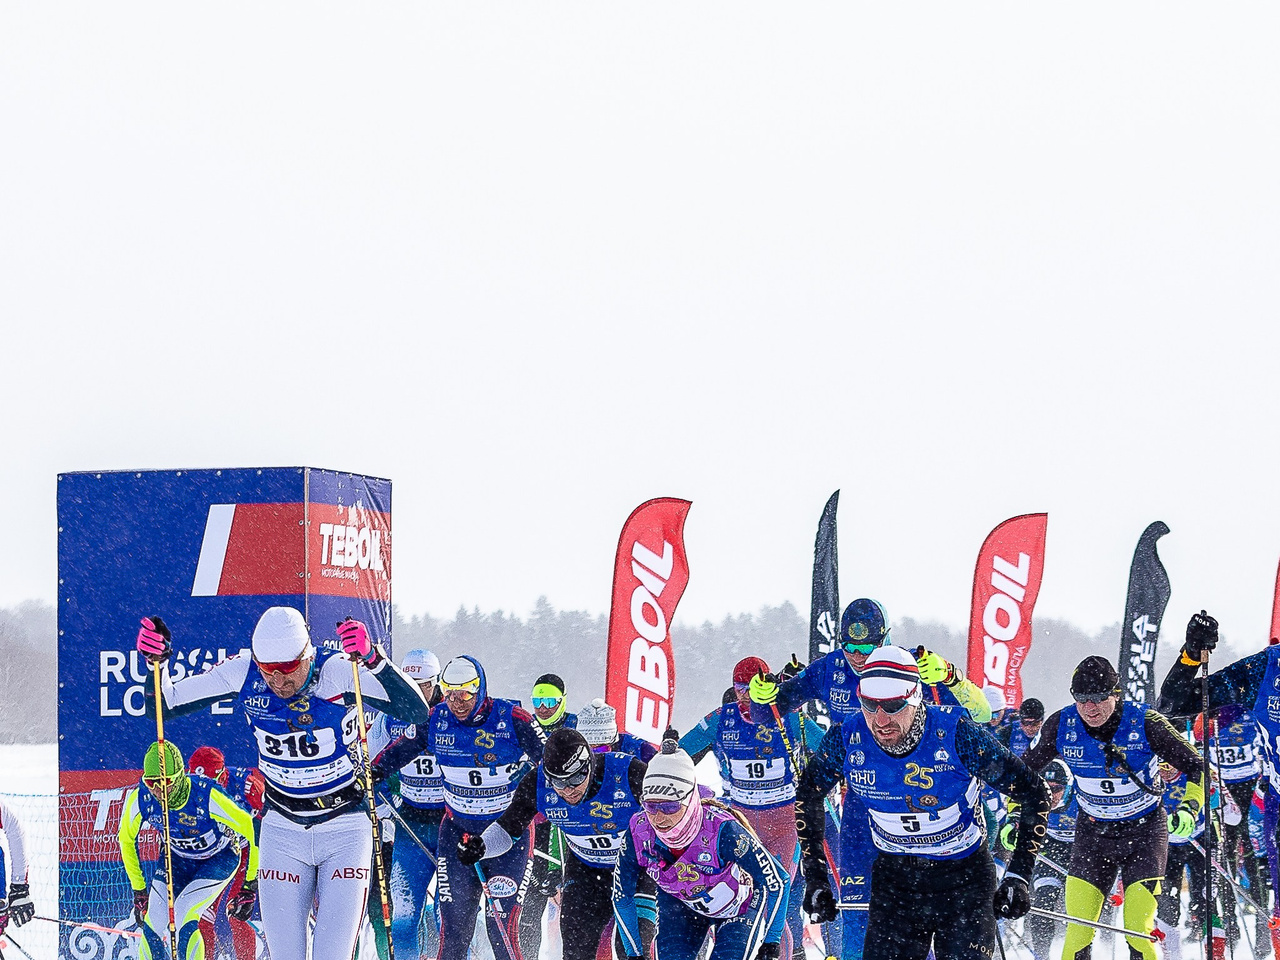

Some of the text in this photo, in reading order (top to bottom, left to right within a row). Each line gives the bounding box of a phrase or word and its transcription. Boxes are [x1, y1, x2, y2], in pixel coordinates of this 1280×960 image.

[475, 729, 495, 749] 25
[756, 725, 773, 743] 25
[264, 735, 320, 757] 316
[414, 759, 434, 775] 13
[745, 763, 764, 778] 19
[903, 762, 935, 789] 25
[468, 770, 483, 787] 6
[1100, 780, 1115, 794] 9
[589, 801, 613, 819] 25
[901, 815, 920, 832] 5
[584, 837, 612, 848] 10
[331, 868, 370, 881] ABST
[438, 857, 452, 902] SATURN
[673, 862, 700, 882] 25
[755, 852, 779, 892] CRAFT
[516, 859, 534, 905] SATURN
